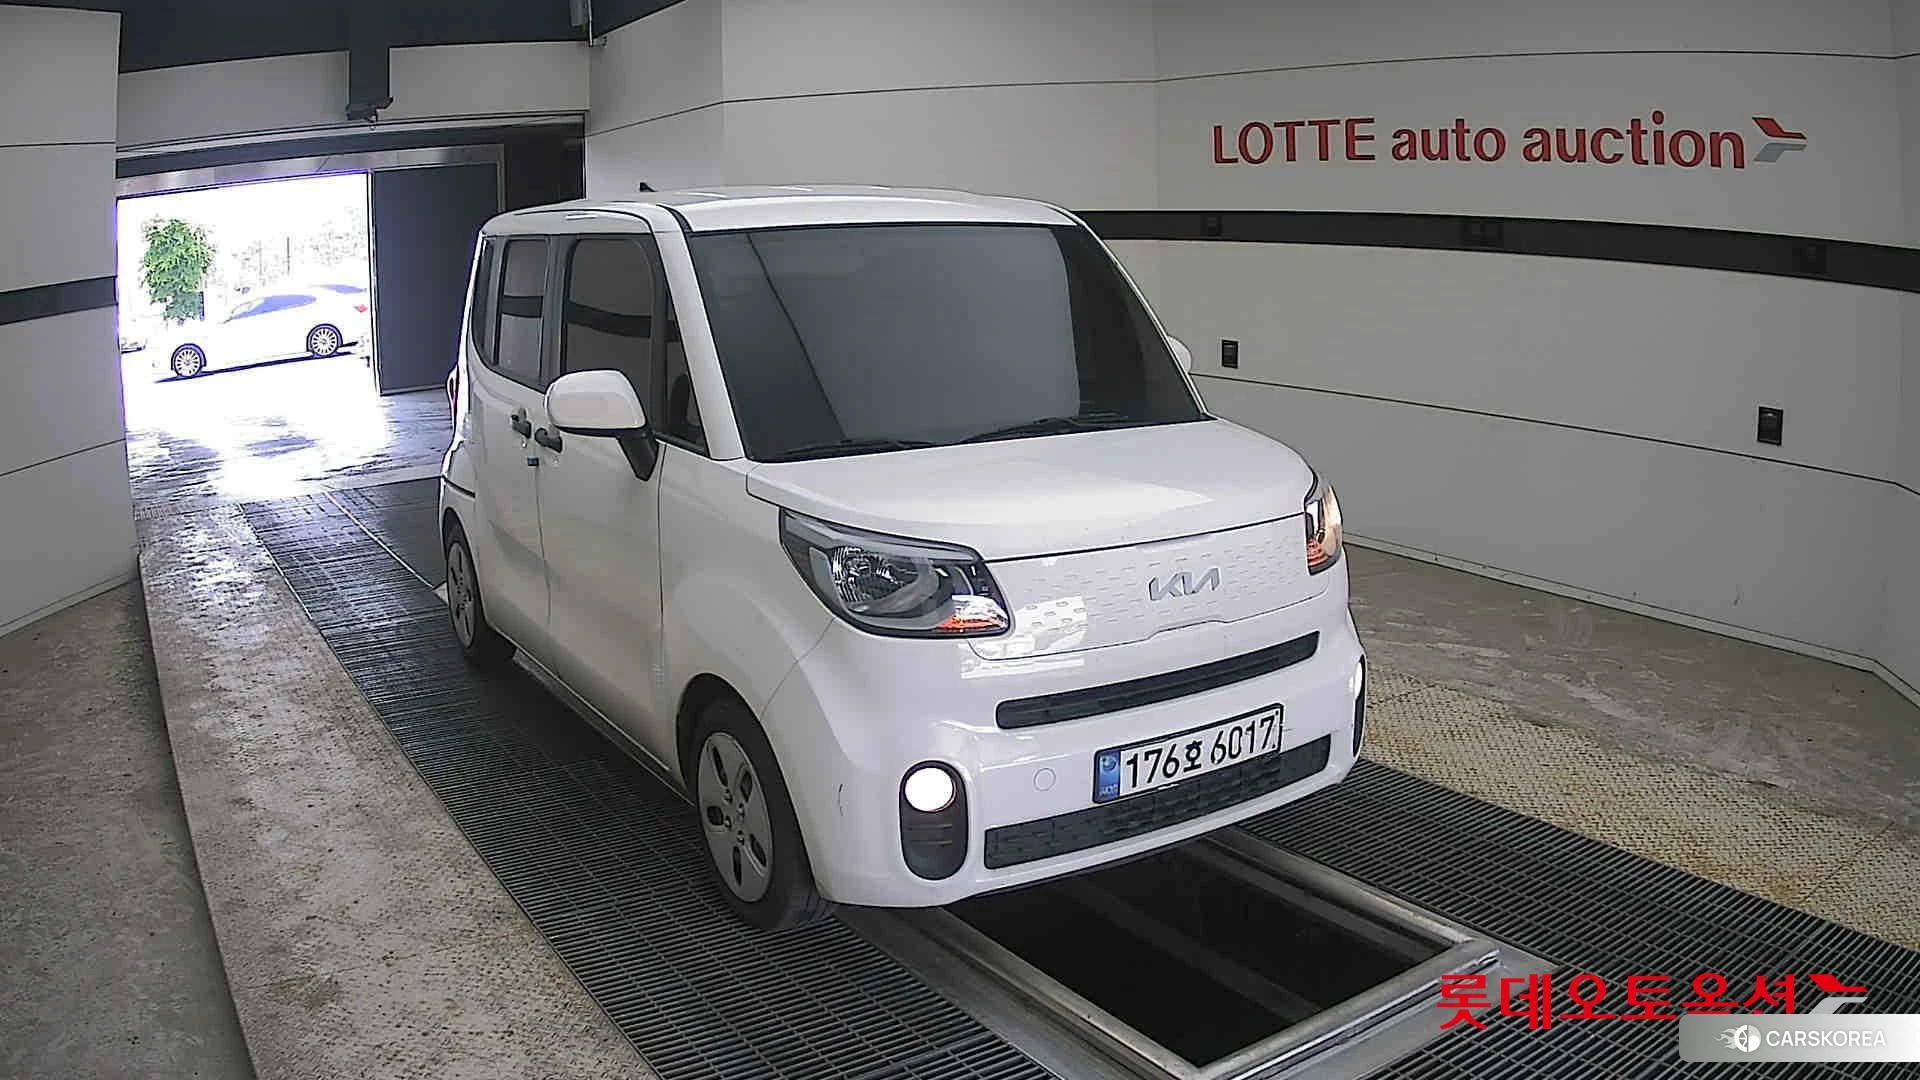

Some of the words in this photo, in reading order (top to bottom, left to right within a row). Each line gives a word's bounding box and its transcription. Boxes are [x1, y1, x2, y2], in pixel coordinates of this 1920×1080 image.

[1212, 117, 1376, 165] LOTTE
[1391, 118, 1507, 162] auto
[1522, 110, 1745, 169] auction
[1148, 567, 1221, 601] KIA
[1126, 740, 1203, 788] 176호
[1210, 715, 1275, 765] 6017
